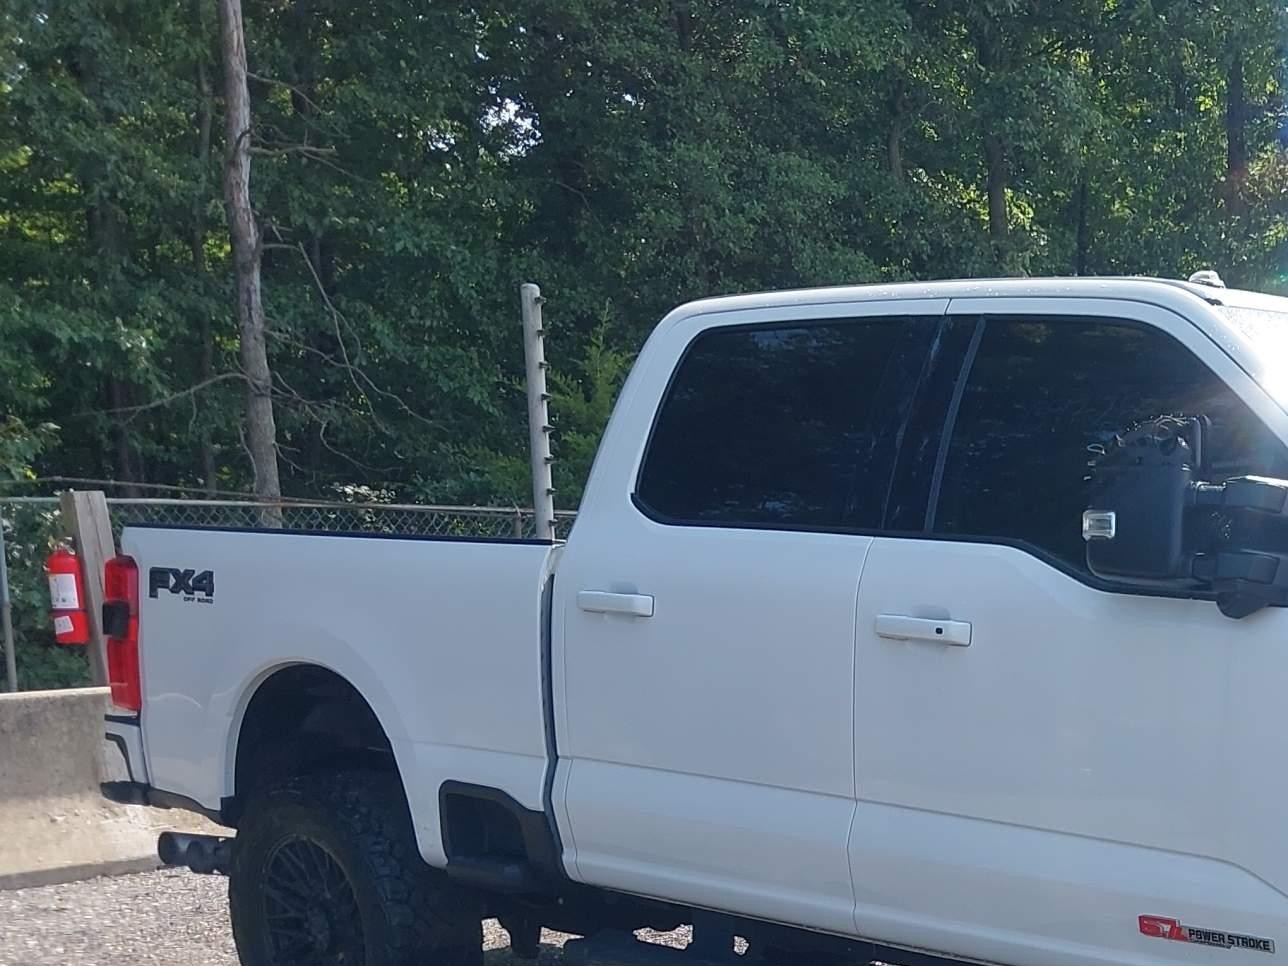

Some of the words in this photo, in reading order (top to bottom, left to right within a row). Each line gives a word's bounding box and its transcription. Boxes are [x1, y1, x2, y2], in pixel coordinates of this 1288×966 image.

[149, 567, 214, 599] FX4
[1188, 928, 1226, 945] POWER
[1227, 934, 1271, 951] STROKE
